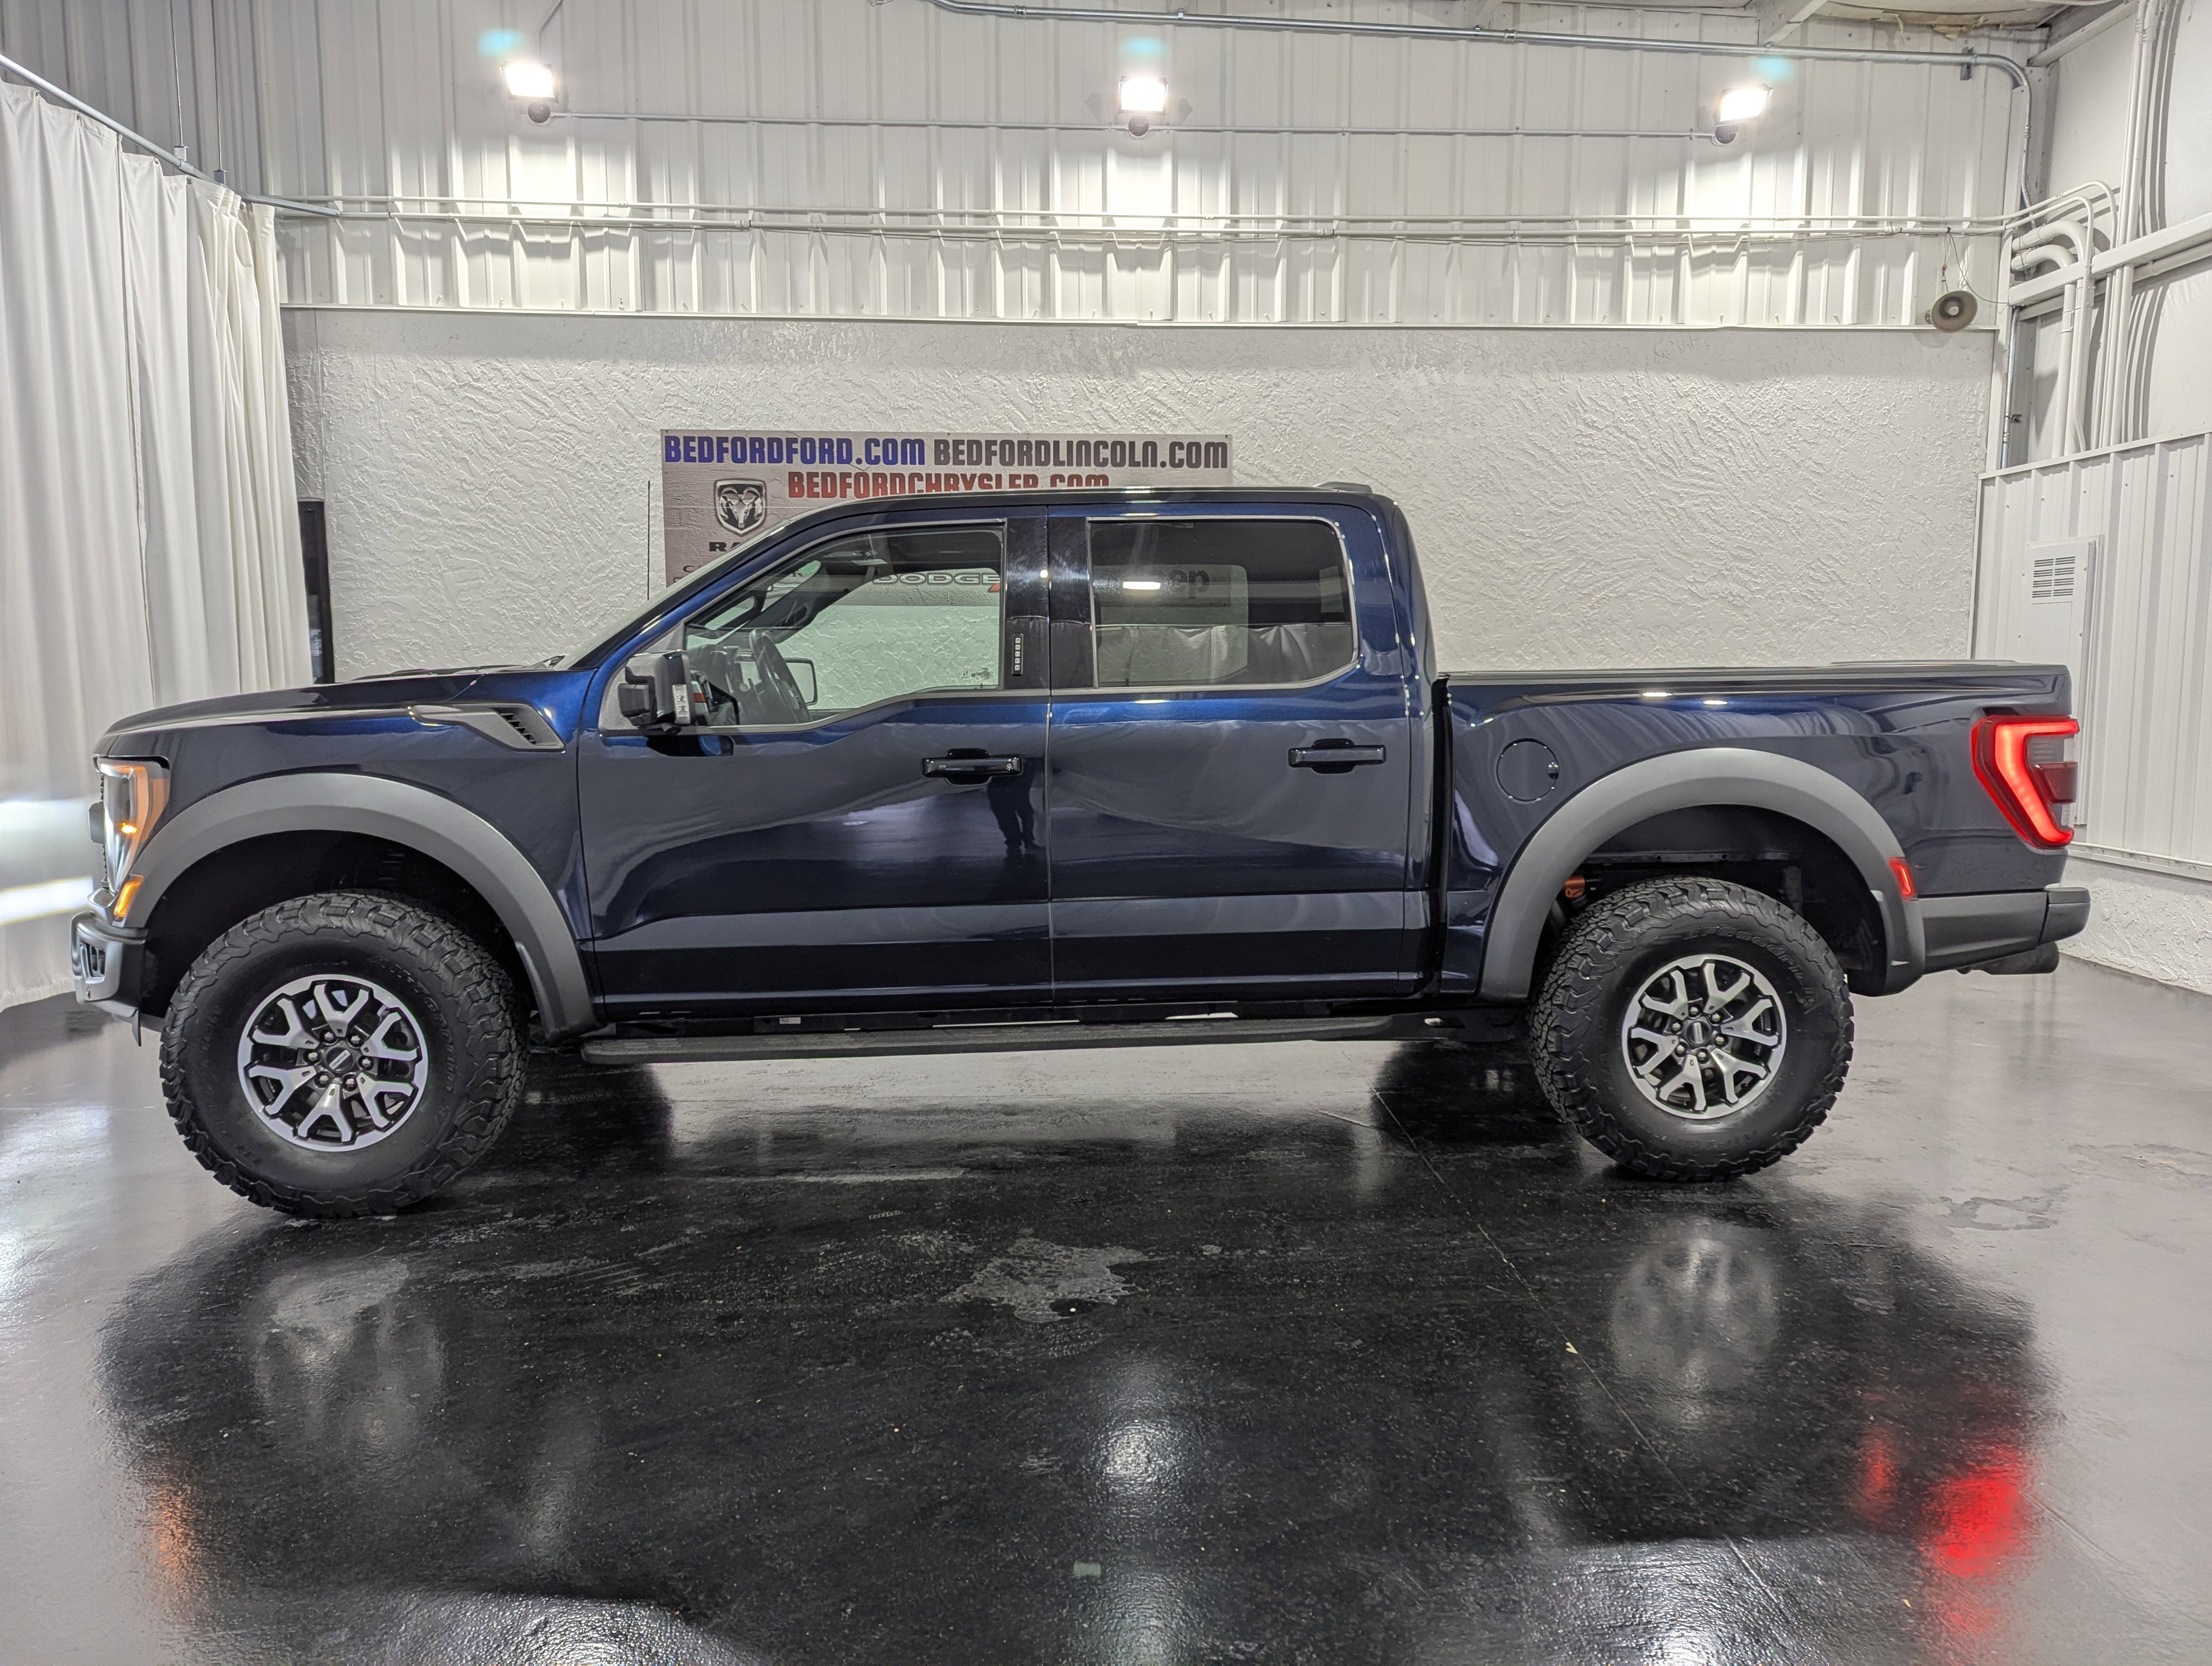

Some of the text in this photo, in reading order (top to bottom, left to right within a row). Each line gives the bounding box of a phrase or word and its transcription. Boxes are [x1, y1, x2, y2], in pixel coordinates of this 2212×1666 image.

[664, 435, 1228, 469] BEDFORDFORD.COM BEDFORDLINCOLN.COM
[788, 471, 1109, 498] BEDFORDCHRYSLERC
[872, 572, 1000, 585] DODGE
